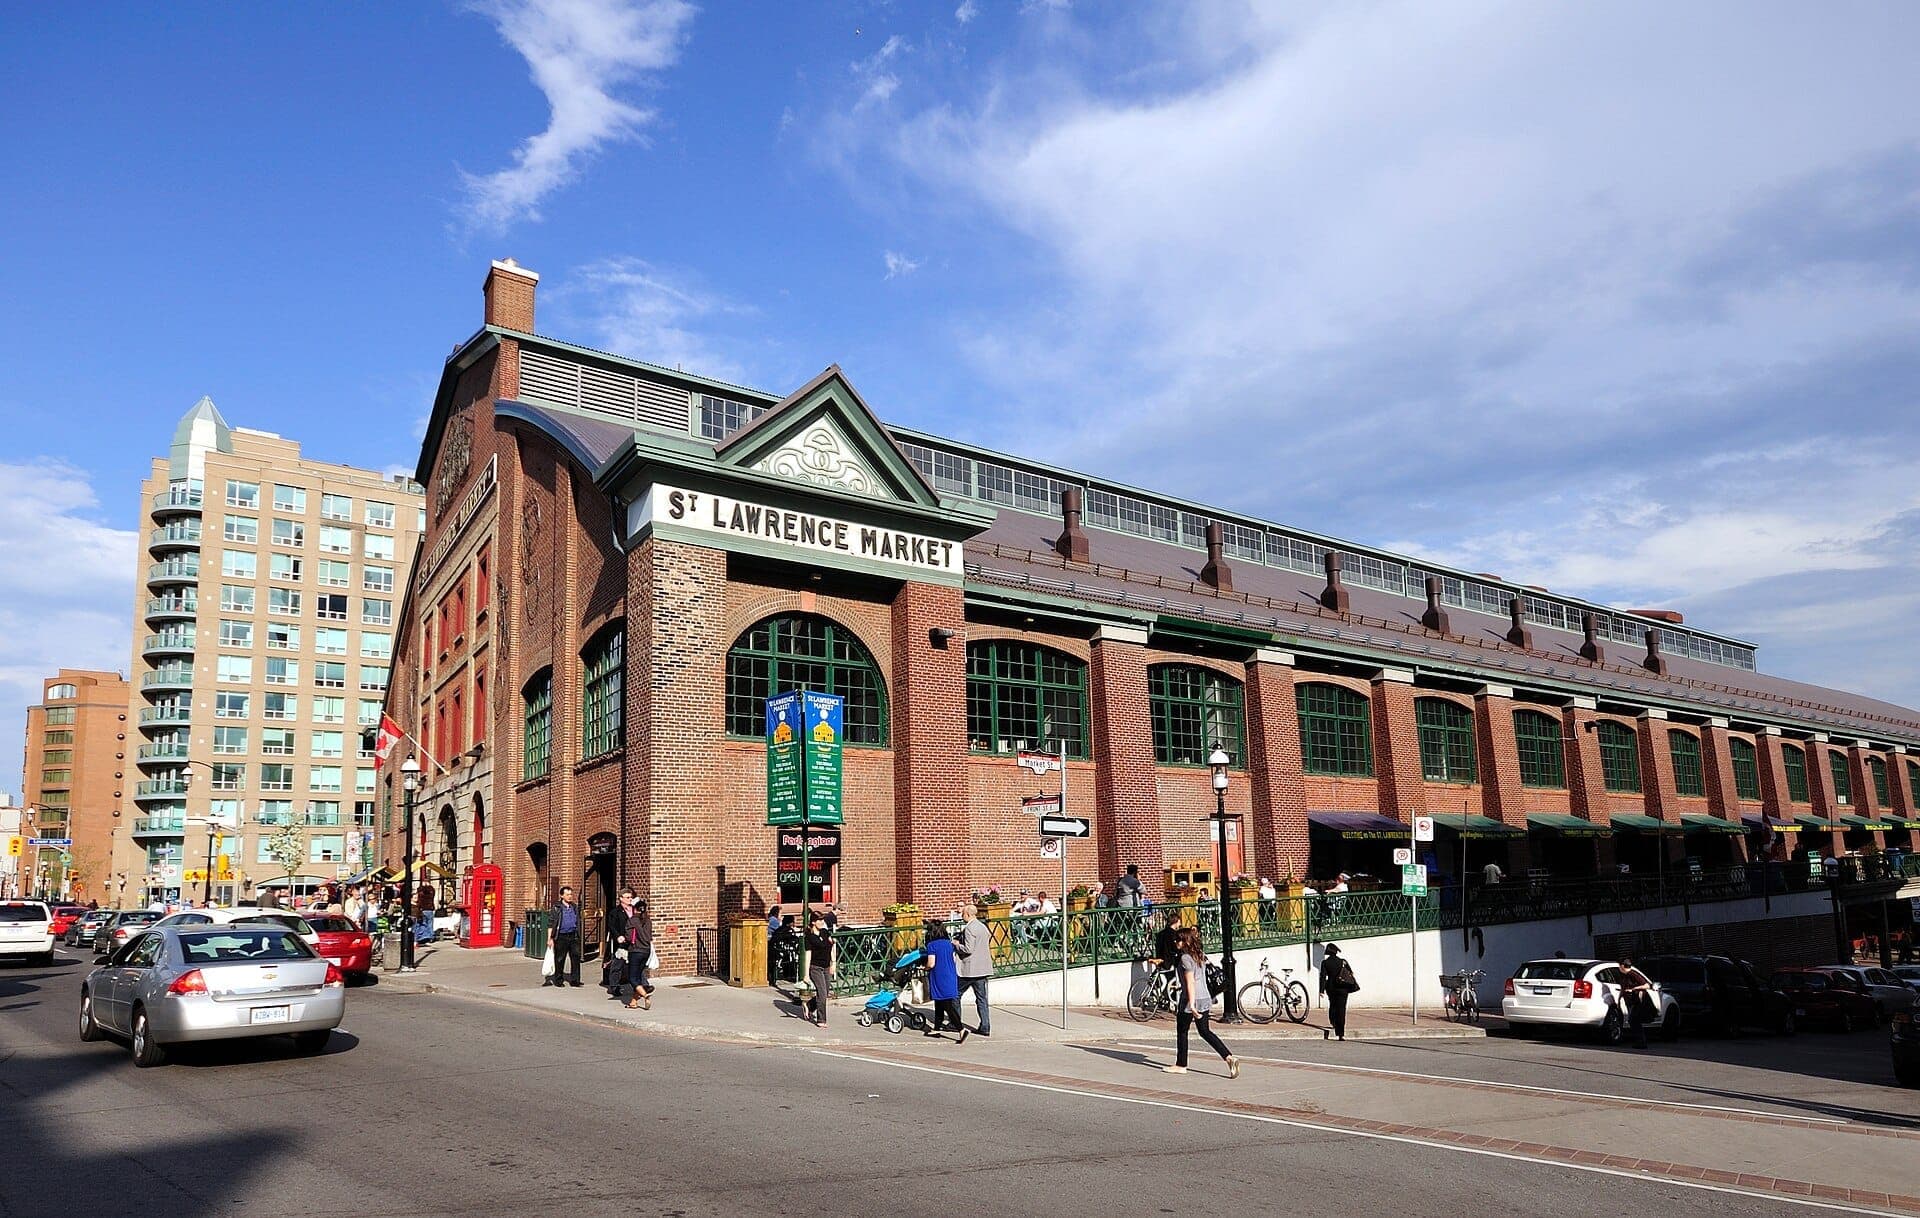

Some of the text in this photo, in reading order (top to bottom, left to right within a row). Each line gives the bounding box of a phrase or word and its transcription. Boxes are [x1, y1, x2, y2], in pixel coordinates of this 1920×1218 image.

[713, 498, 849, 550] LAWRENCE
[861, 527, 953, 568] MARKET
[1024, 759, 1046, 769] Market
[779, 861, 823, 871] RESTAANT
[779, 872, 801, 883] OPEN
